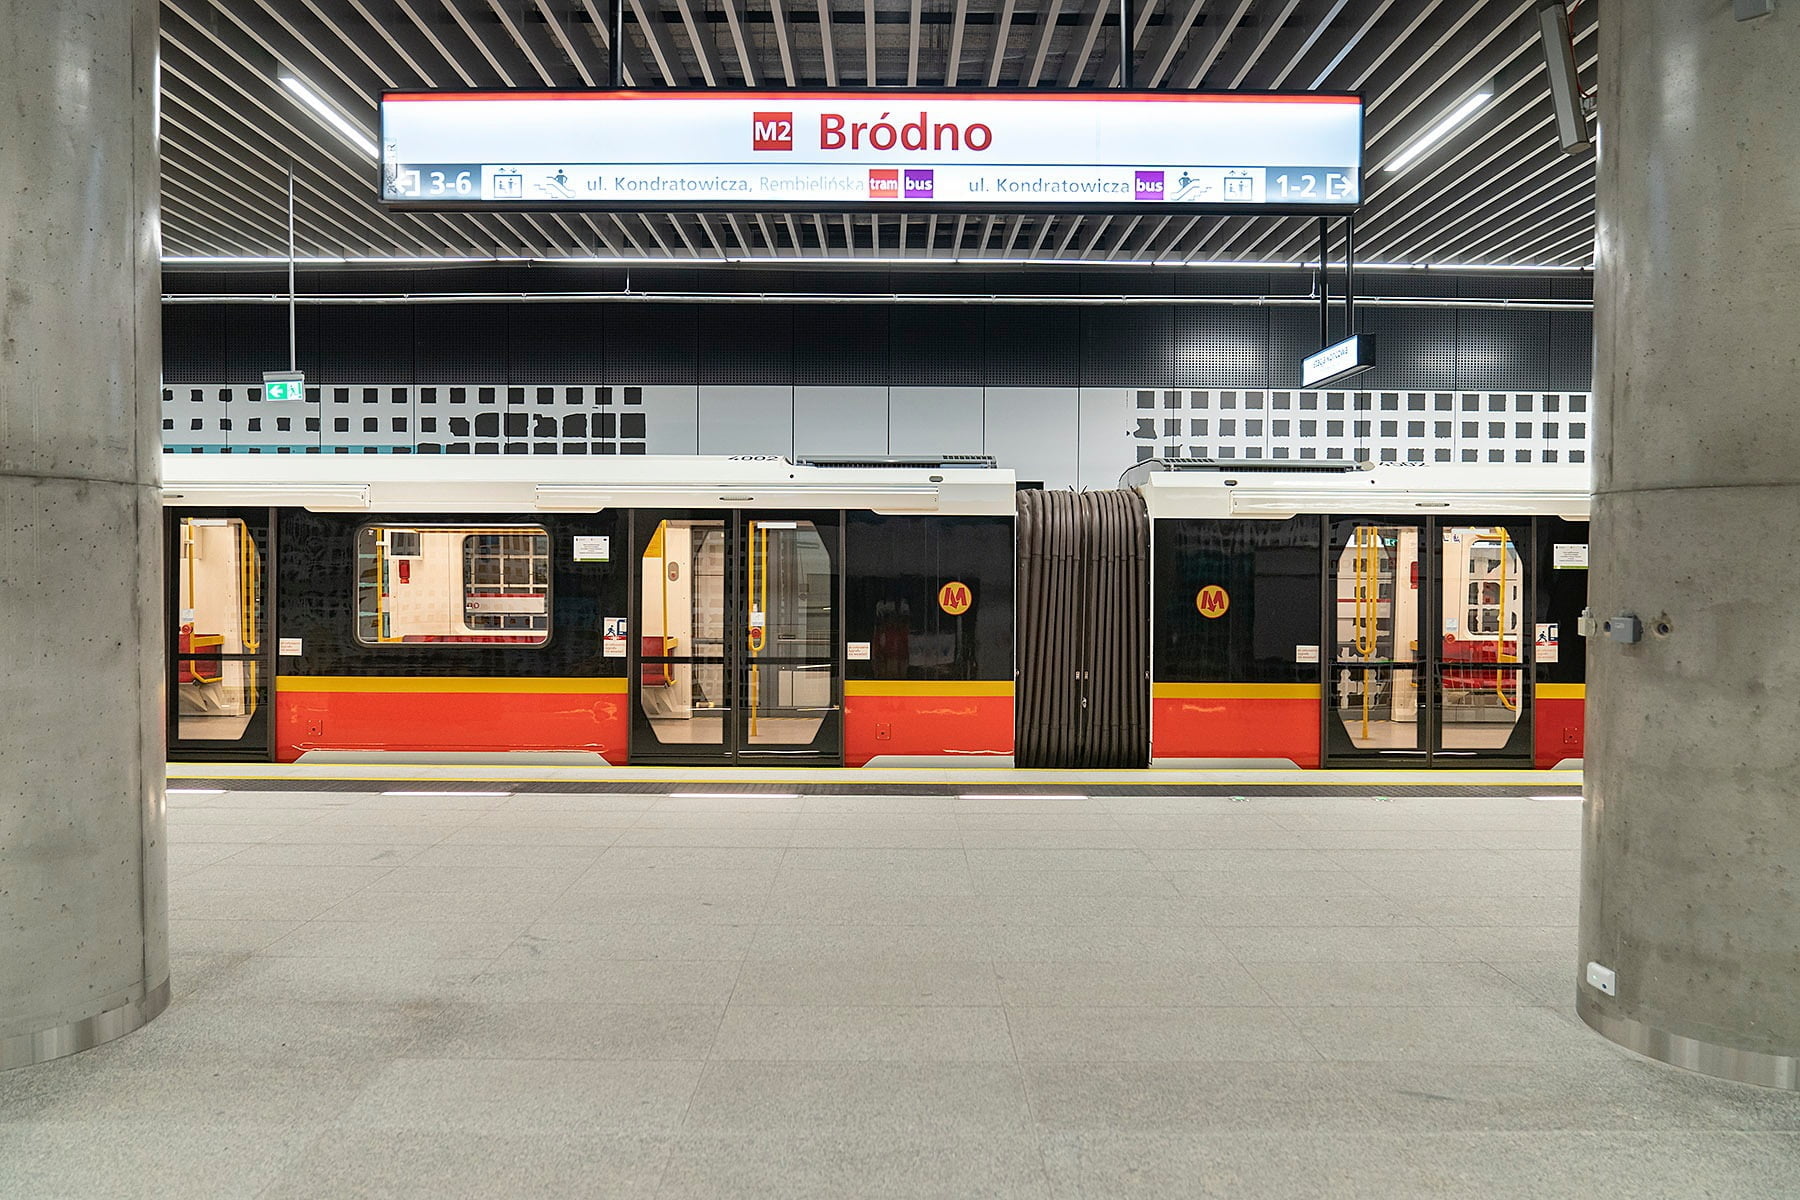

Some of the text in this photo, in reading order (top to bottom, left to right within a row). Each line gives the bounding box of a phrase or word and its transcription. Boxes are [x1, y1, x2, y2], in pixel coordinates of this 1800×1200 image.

[755, 112, 992, 150] M2 Bródno
[430, 171, 933, 195] 3-6 ul. Kondratowicza, Rembielińska tram bus
[969, 174, 1317, 197] ul. Kondratowicza bus 1-2
